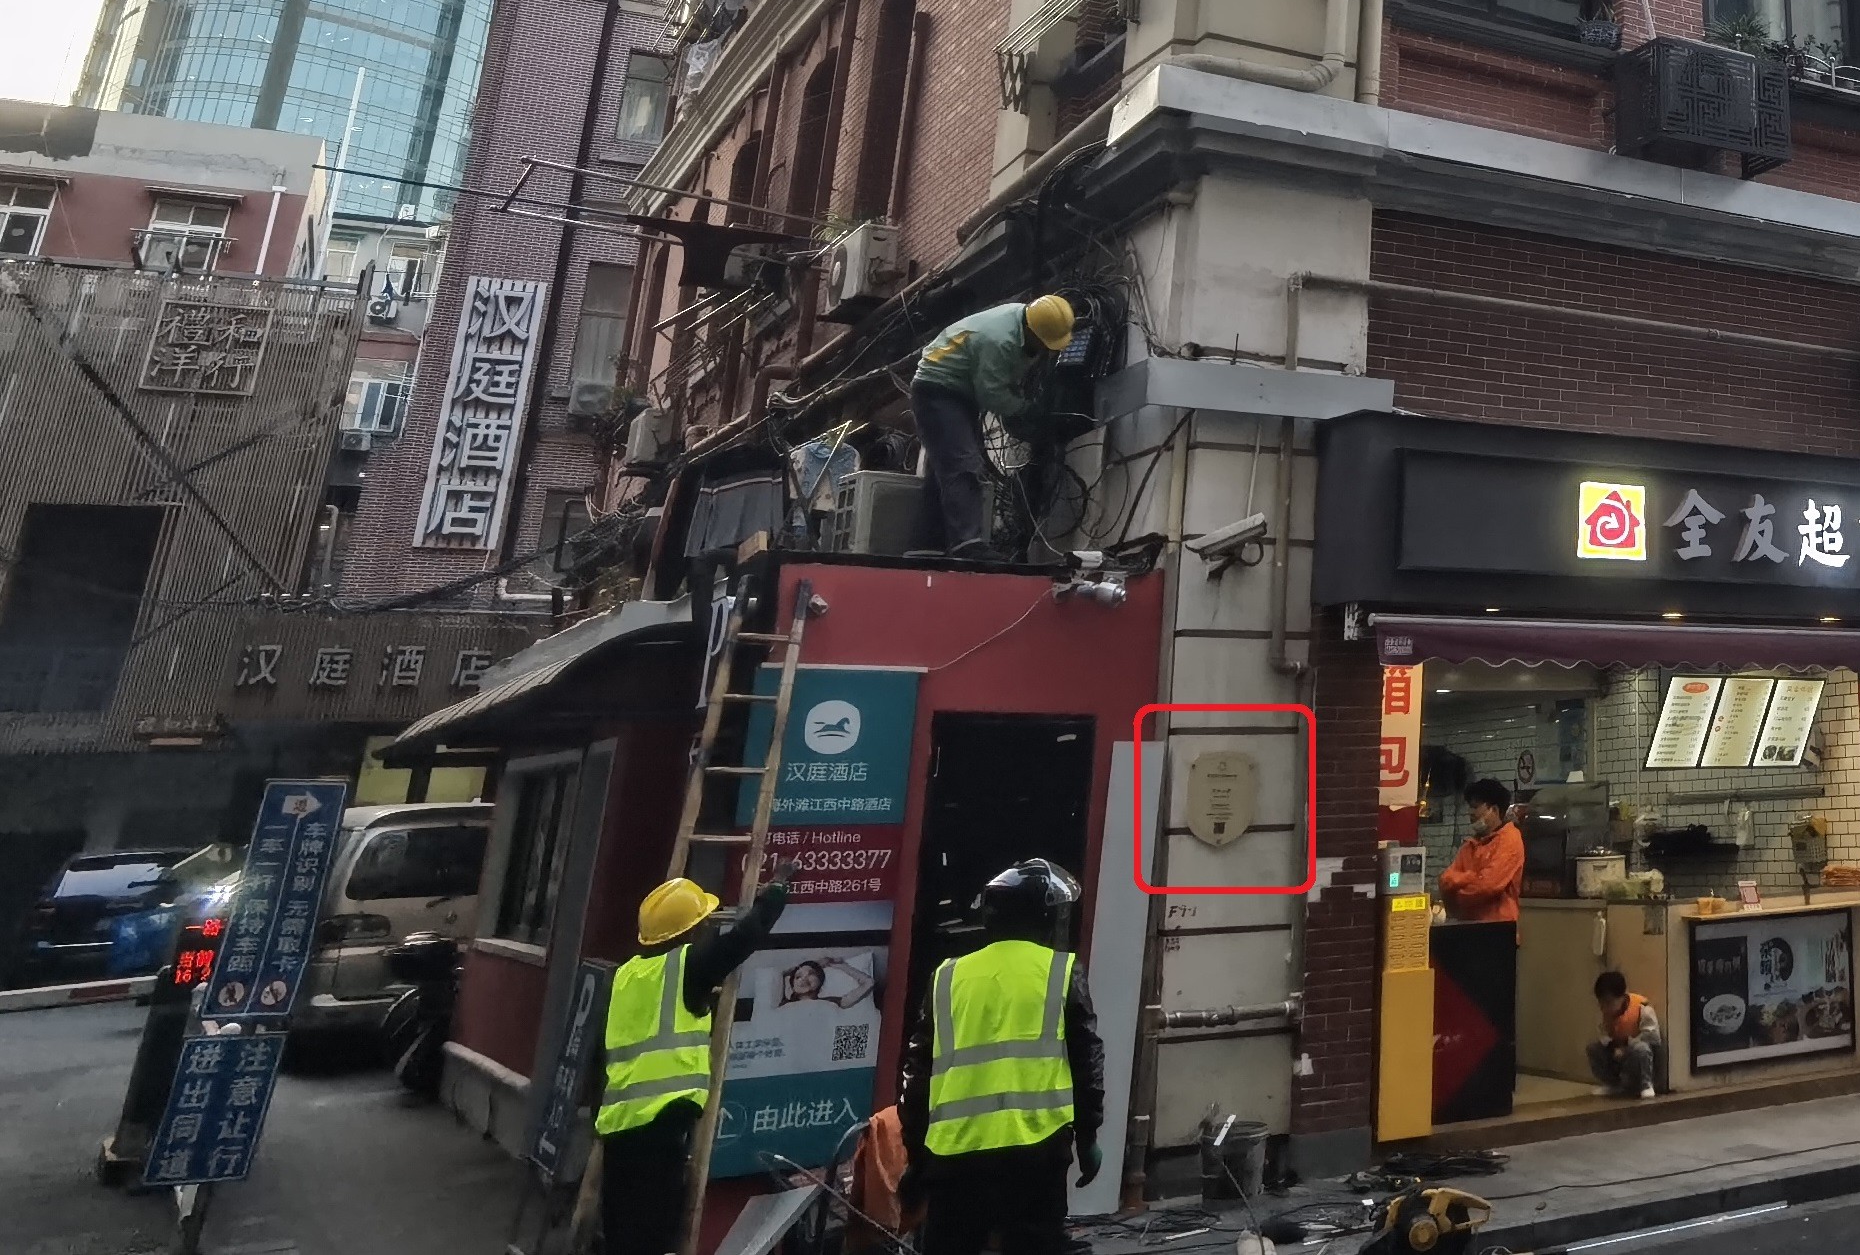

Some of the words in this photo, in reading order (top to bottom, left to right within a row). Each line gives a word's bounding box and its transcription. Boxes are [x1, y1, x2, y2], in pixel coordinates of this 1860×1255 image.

[426, 285, 531, 536] 汉庭酒店
[235, 645, 493, 688] 汉庭酒店
[785, 762, 869, 782] 汉庭酒店
[760, 797, 892, 813] 海外滩江西中路酒店
[811, 831, 861, 845] Hotline
[156, 1042, 225, 1179] 进出同道
[207, 1042, 272, 1177] 注意让行
[752, 1097, 859, 1134] 由此进入
